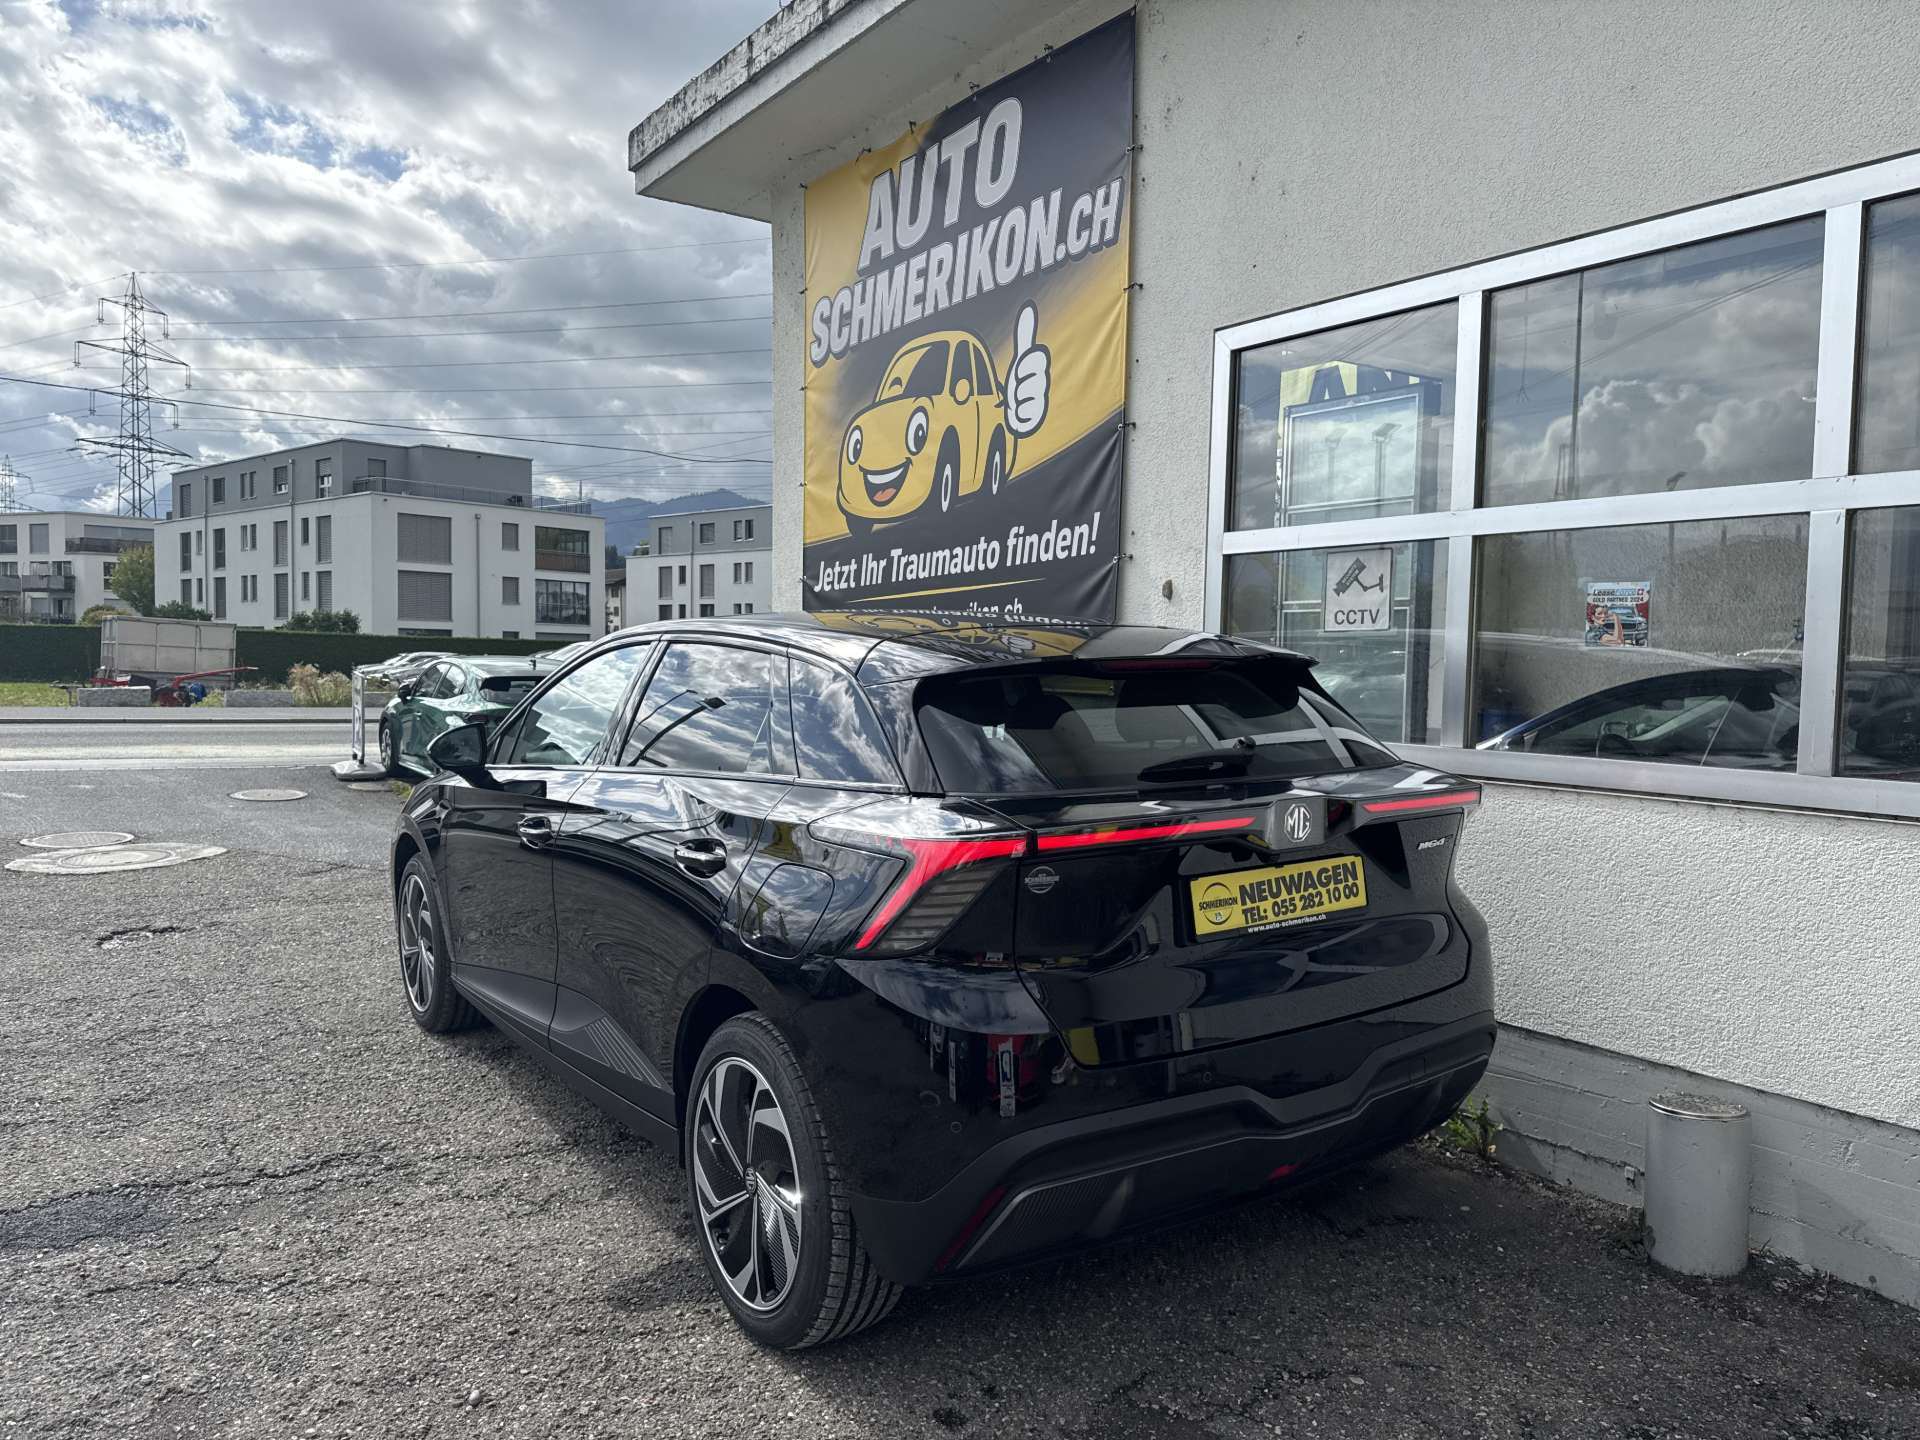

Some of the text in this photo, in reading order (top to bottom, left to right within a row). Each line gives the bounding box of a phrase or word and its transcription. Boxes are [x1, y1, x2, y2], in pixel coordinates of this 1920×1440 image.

[858, 97, 1022, 272] AUTO
[810, 177, 1122, 363] SCHMERIKON.CH
[814, 512, 1100, 592] Jetzt Ihr Traumauto finden!
[1334, 608, 1380, 625] CCTV
[1286, 806, 1310, 839] MG
[1238, 861, 1359, 906] NEUWAGEN
[1241, 882, 1359, 925] TEL: 055 282 10 00
